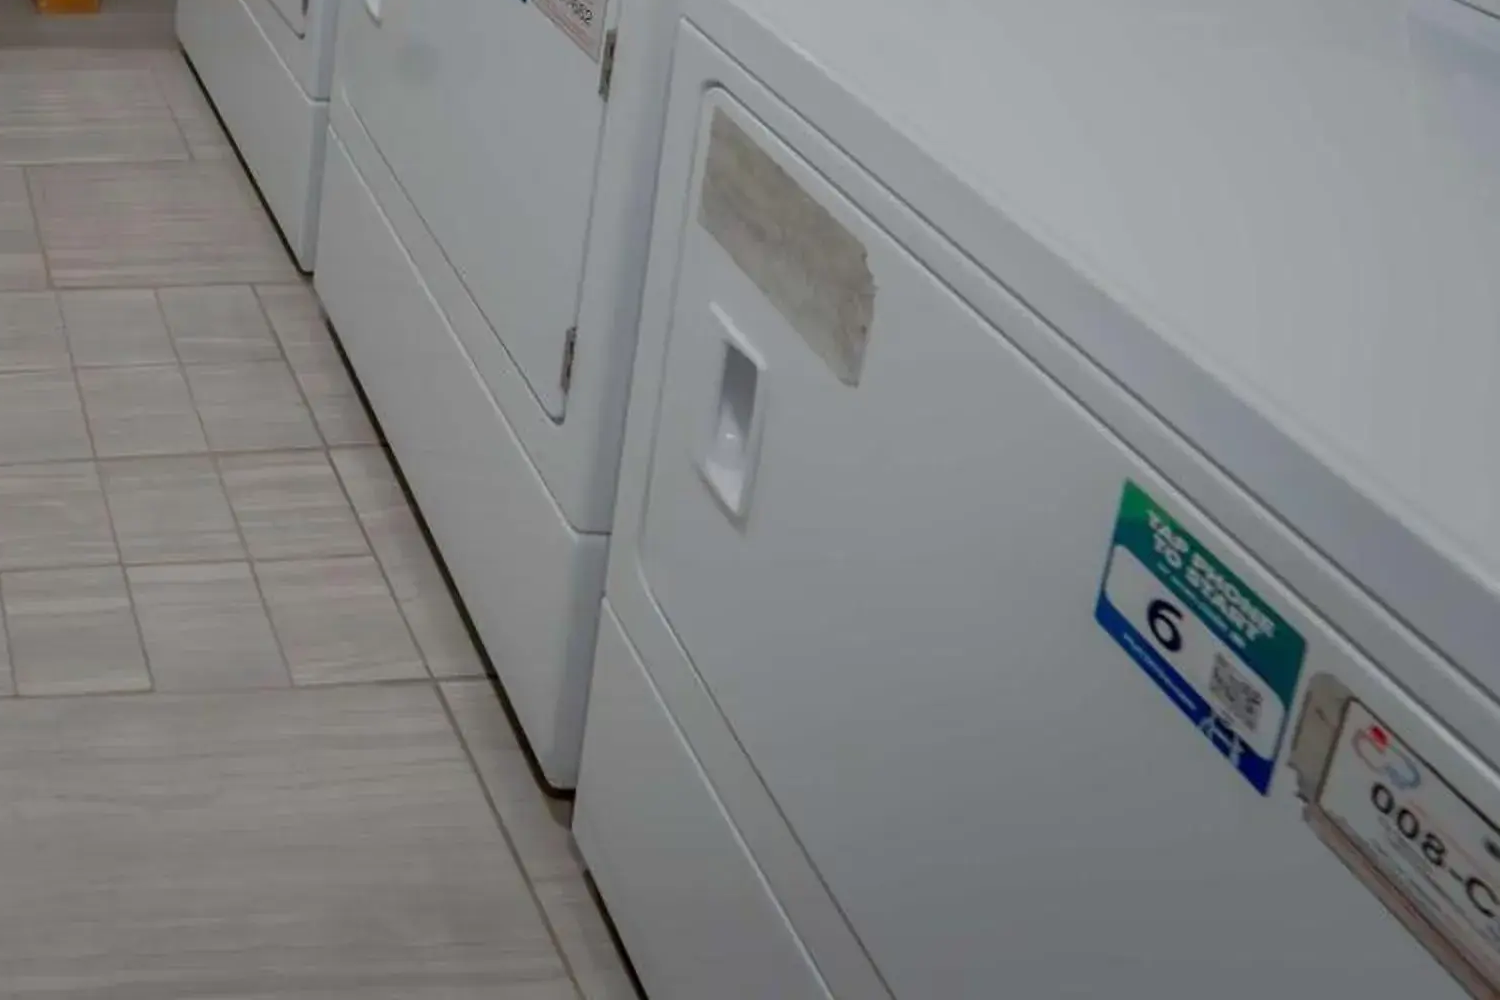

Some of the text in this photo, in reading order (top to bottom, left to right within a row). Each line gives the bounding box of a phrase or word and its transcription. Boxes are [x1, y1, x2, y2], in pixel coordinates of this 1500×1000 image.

[1146, 599, 1184, 653] 6
[1147, 509, 1190, 553] TAP
[1190, 551, 1276, 639] PHONE
[1152, 532, 1184, 570] TO
[1184, 564, 1257, 642] START
